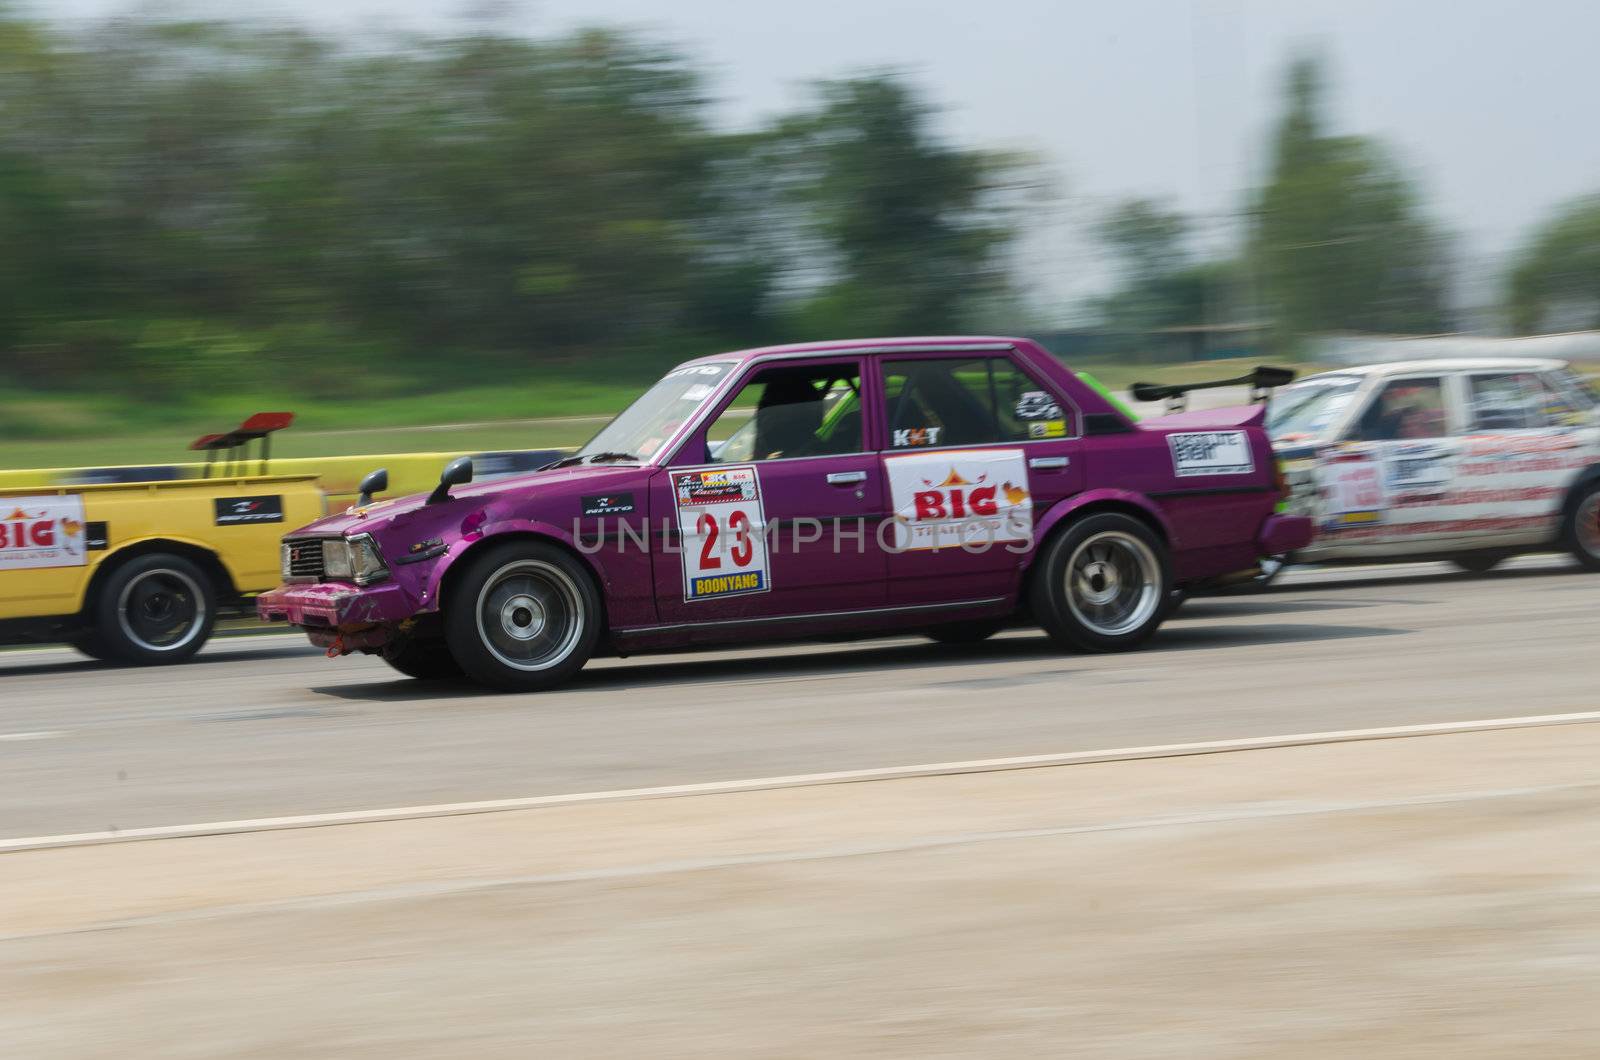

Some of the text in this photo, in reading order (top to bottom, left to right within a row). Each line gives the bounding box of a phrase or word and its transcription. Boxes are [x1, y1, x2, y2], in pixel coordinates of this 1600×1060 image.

[914, 484, 997, 522] BIG
[696, 510, 753, 570] 23
[696, 573, 758, 595] BOONYANG
